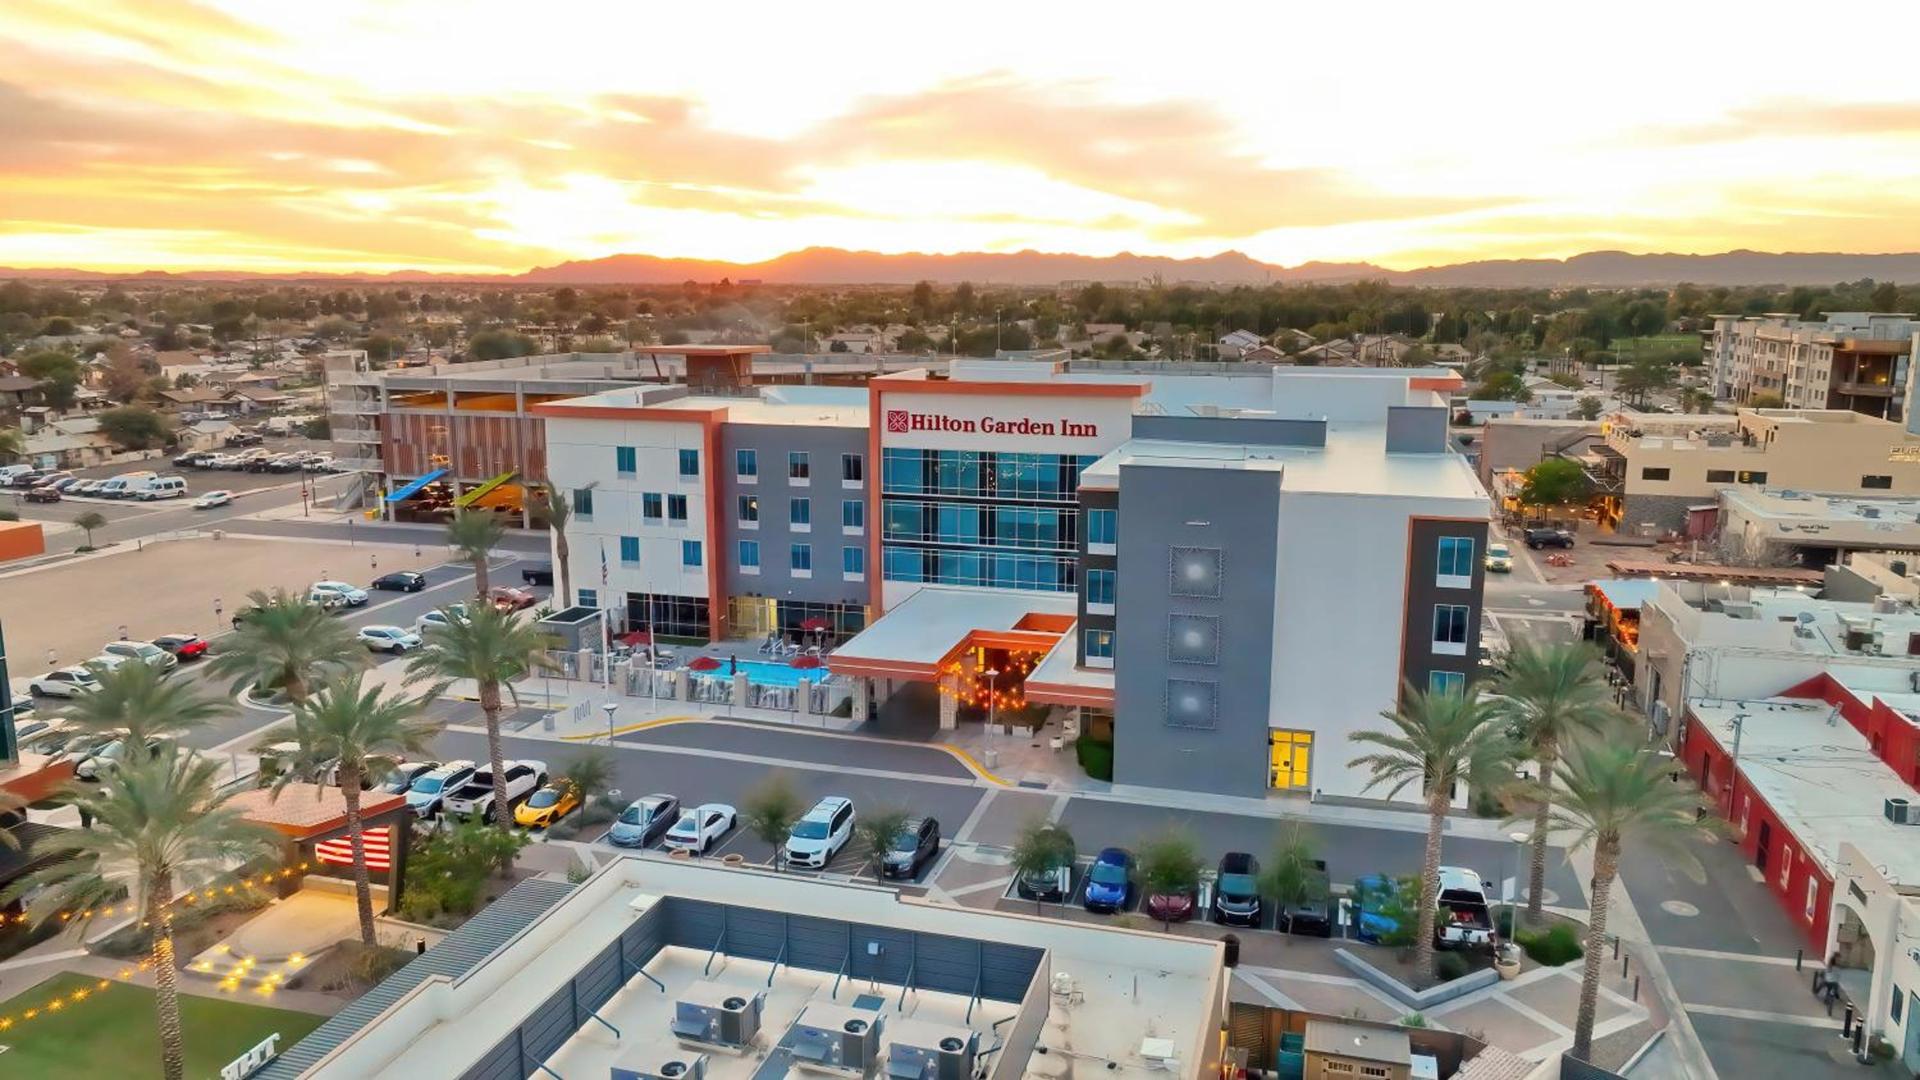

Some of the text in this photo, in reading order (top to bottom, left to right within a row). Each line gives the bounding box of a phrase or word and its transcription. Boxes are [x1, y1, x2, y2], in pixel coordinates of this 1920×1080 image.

[911, 414, 1098, 437] Hilton Garden Inn
